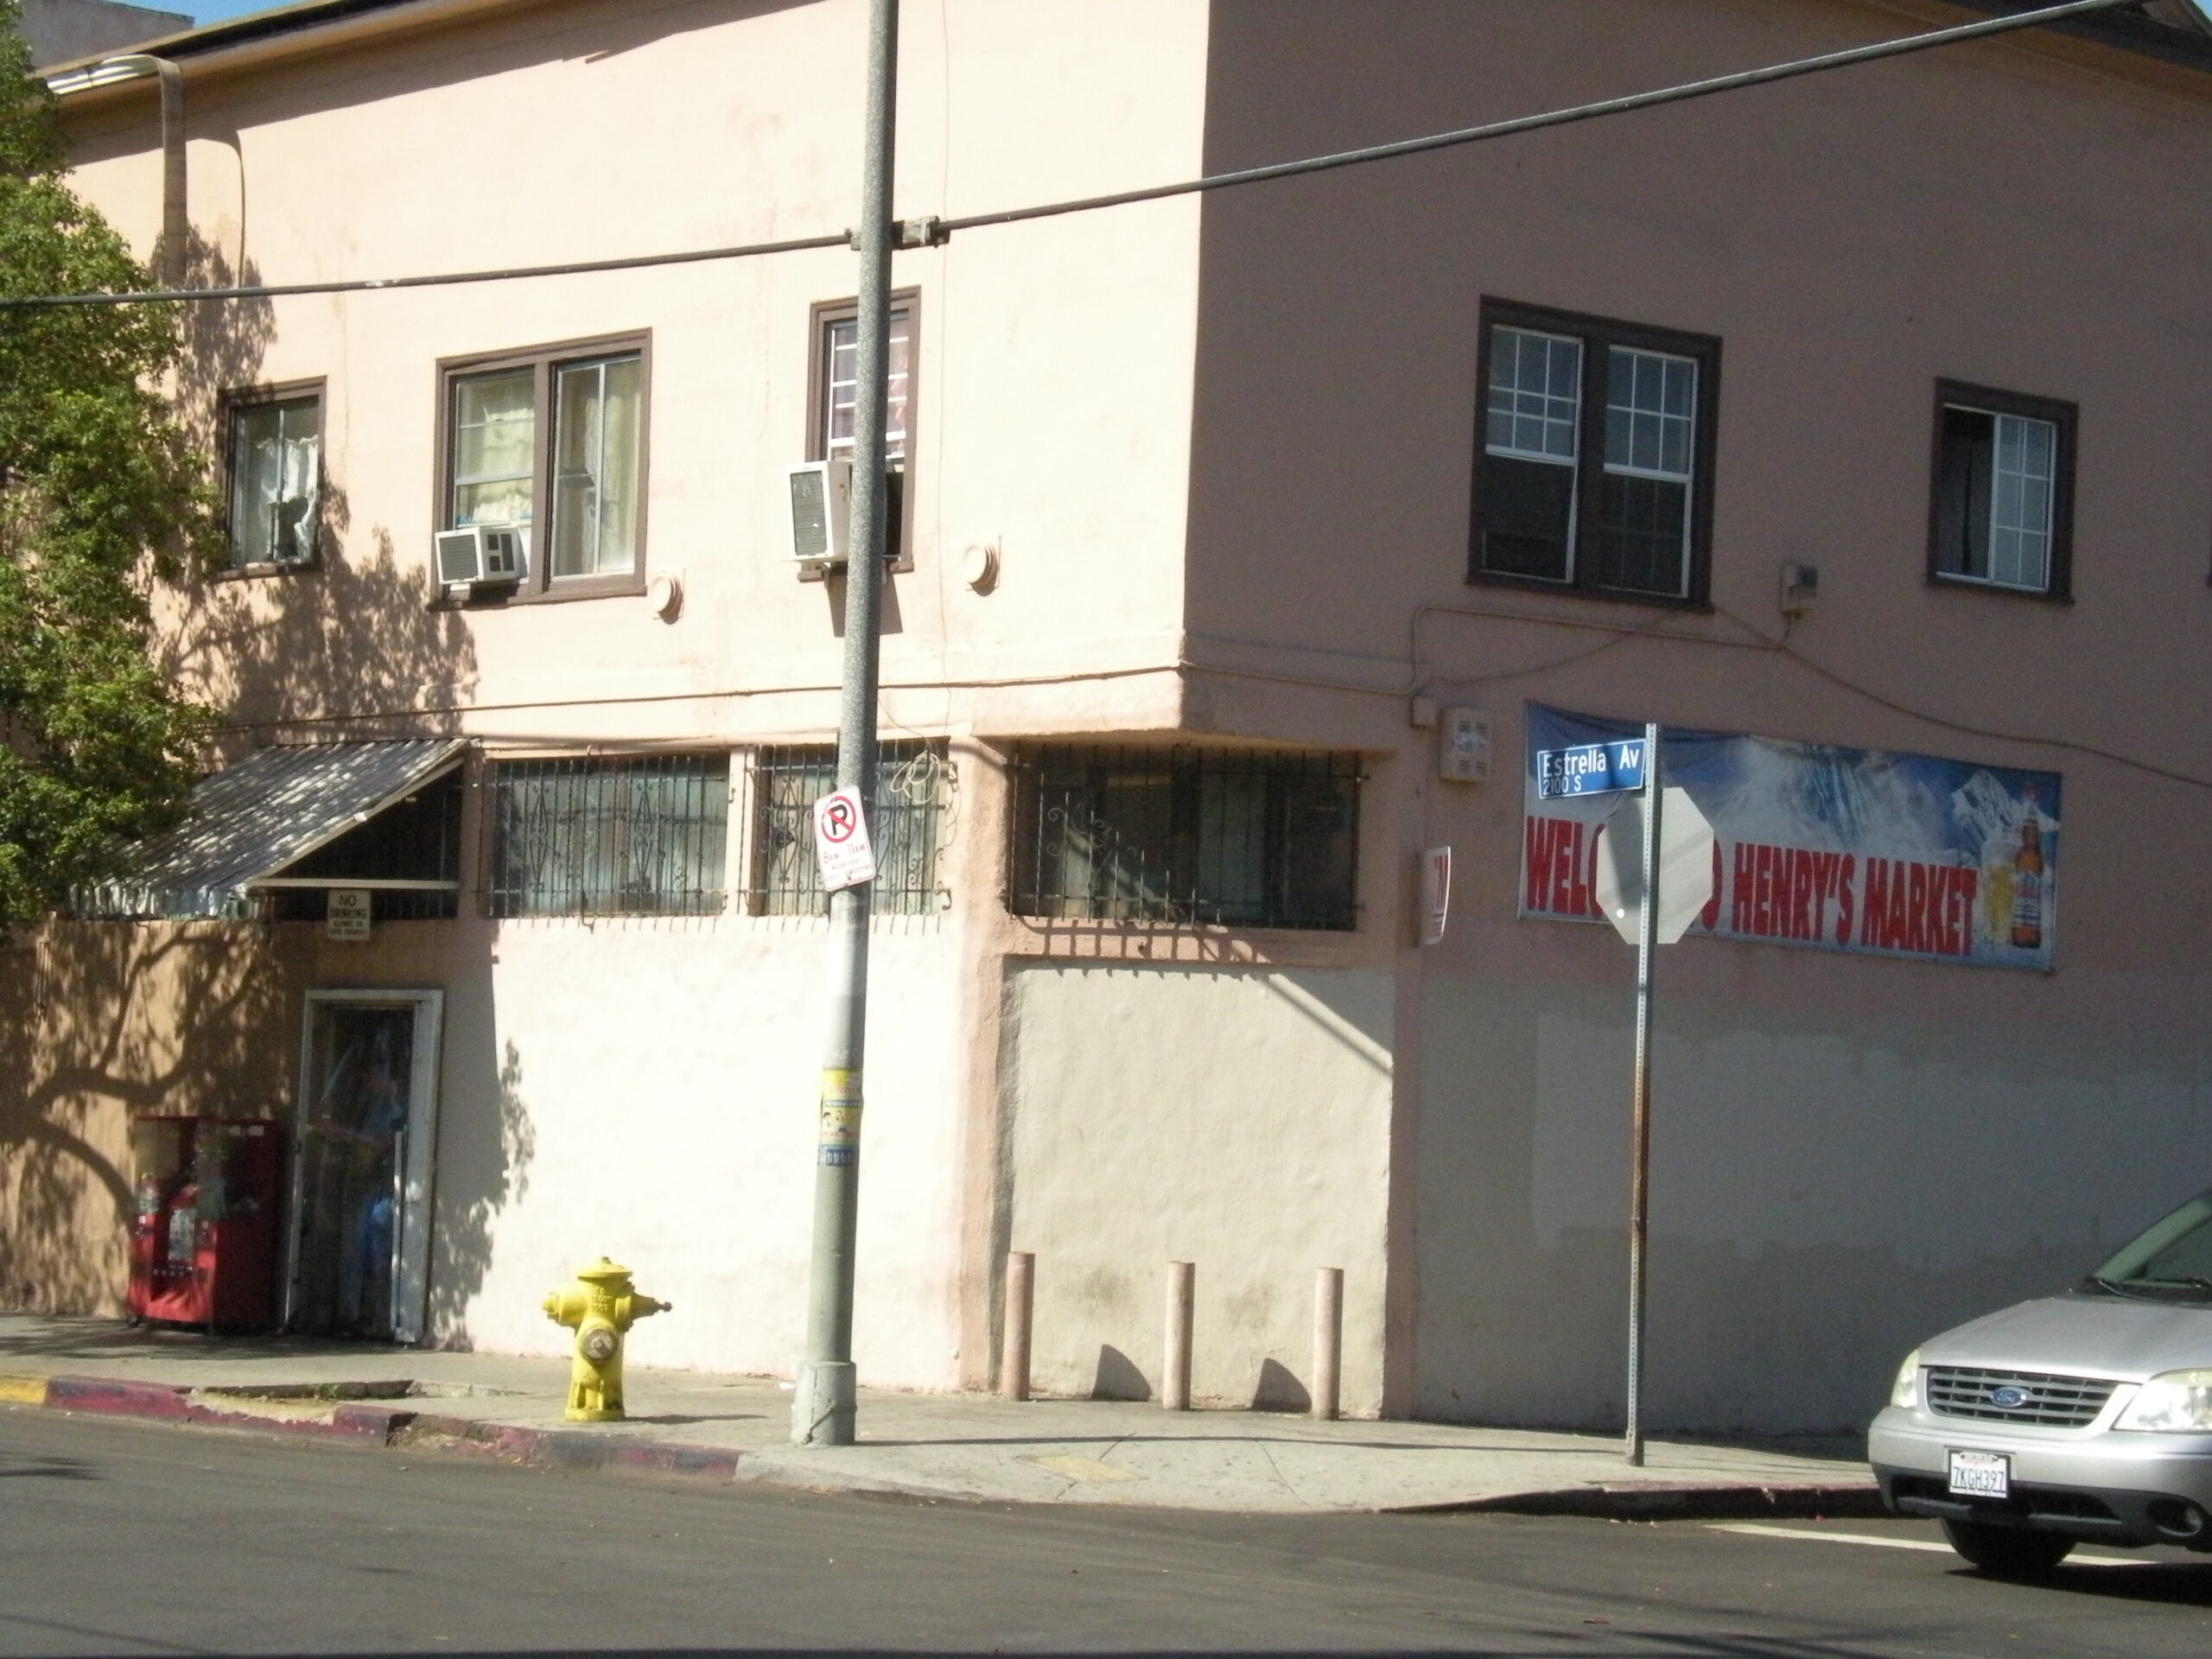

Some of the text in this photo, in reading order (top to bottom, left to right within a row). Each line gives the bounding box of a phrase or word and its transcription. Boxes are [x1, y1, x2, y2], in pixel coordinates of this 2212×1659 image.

[1543, 745, 1640, 778] Estrella Av
[1542, 775, 1582, 796] 2100 S
[339, 894, 357, 907] NO
[1732, 842, 1855, 946] HENRY'S
[1860, 856, 1978, 957] MARKET
[1953, 1466, 2005, 1491] 7KGH397
